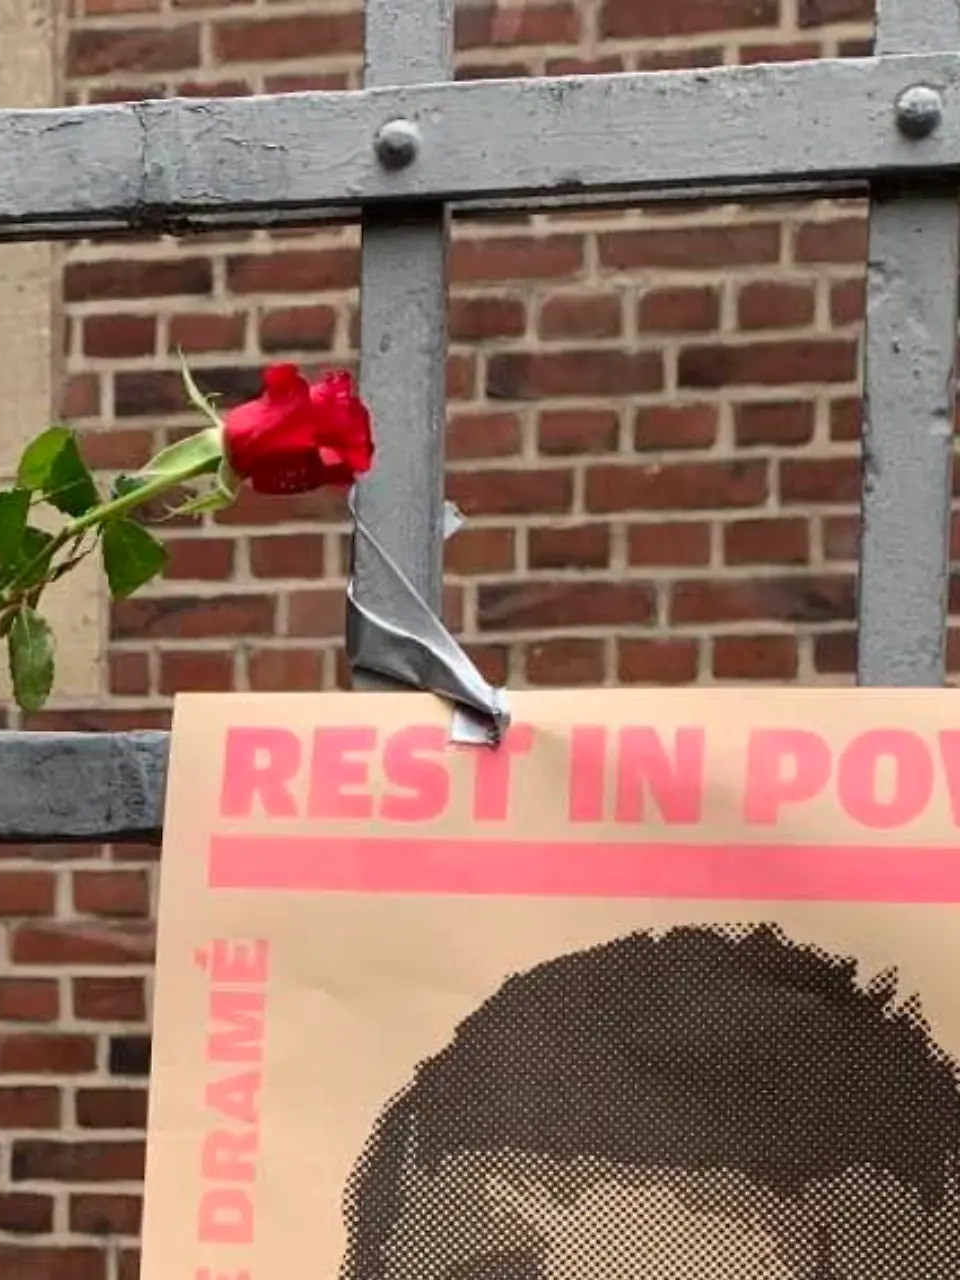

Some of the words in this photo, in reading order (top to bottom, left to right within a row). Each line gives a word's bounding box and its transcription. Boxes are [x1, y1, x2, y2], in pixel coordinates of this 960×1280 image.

[219, 725, 535, 823] REST
[567, 725, 706, 824] IN
[744, 727, 960, 829] PO
[194, 938, 270, 1245] DRAMÉ
